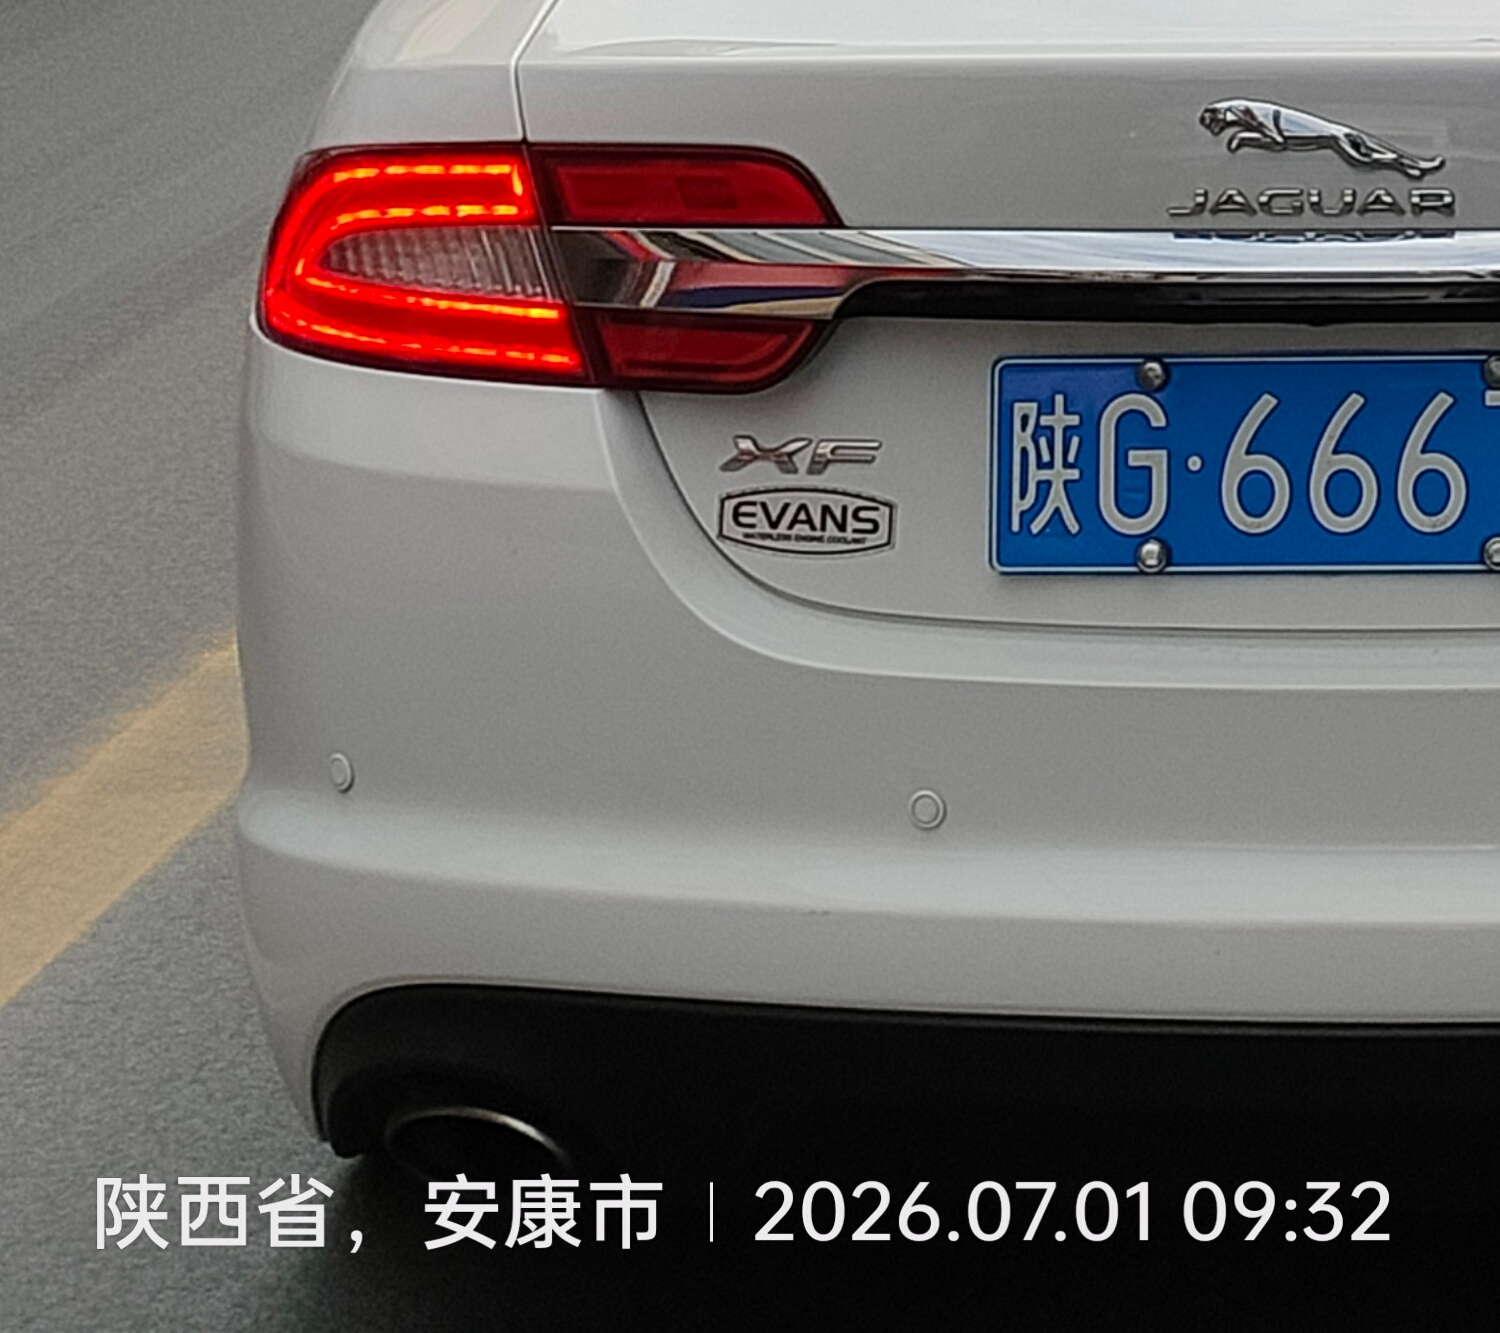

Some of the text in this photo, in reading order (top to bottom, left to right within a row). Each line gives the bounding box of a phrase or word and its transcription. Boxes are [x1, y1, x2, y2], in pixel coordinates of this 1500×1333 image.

[1166, 188, 1456, 217] JAGUAR
[718, 434, 883, 475] XF
[731, 500, 881, 535] EVANS
